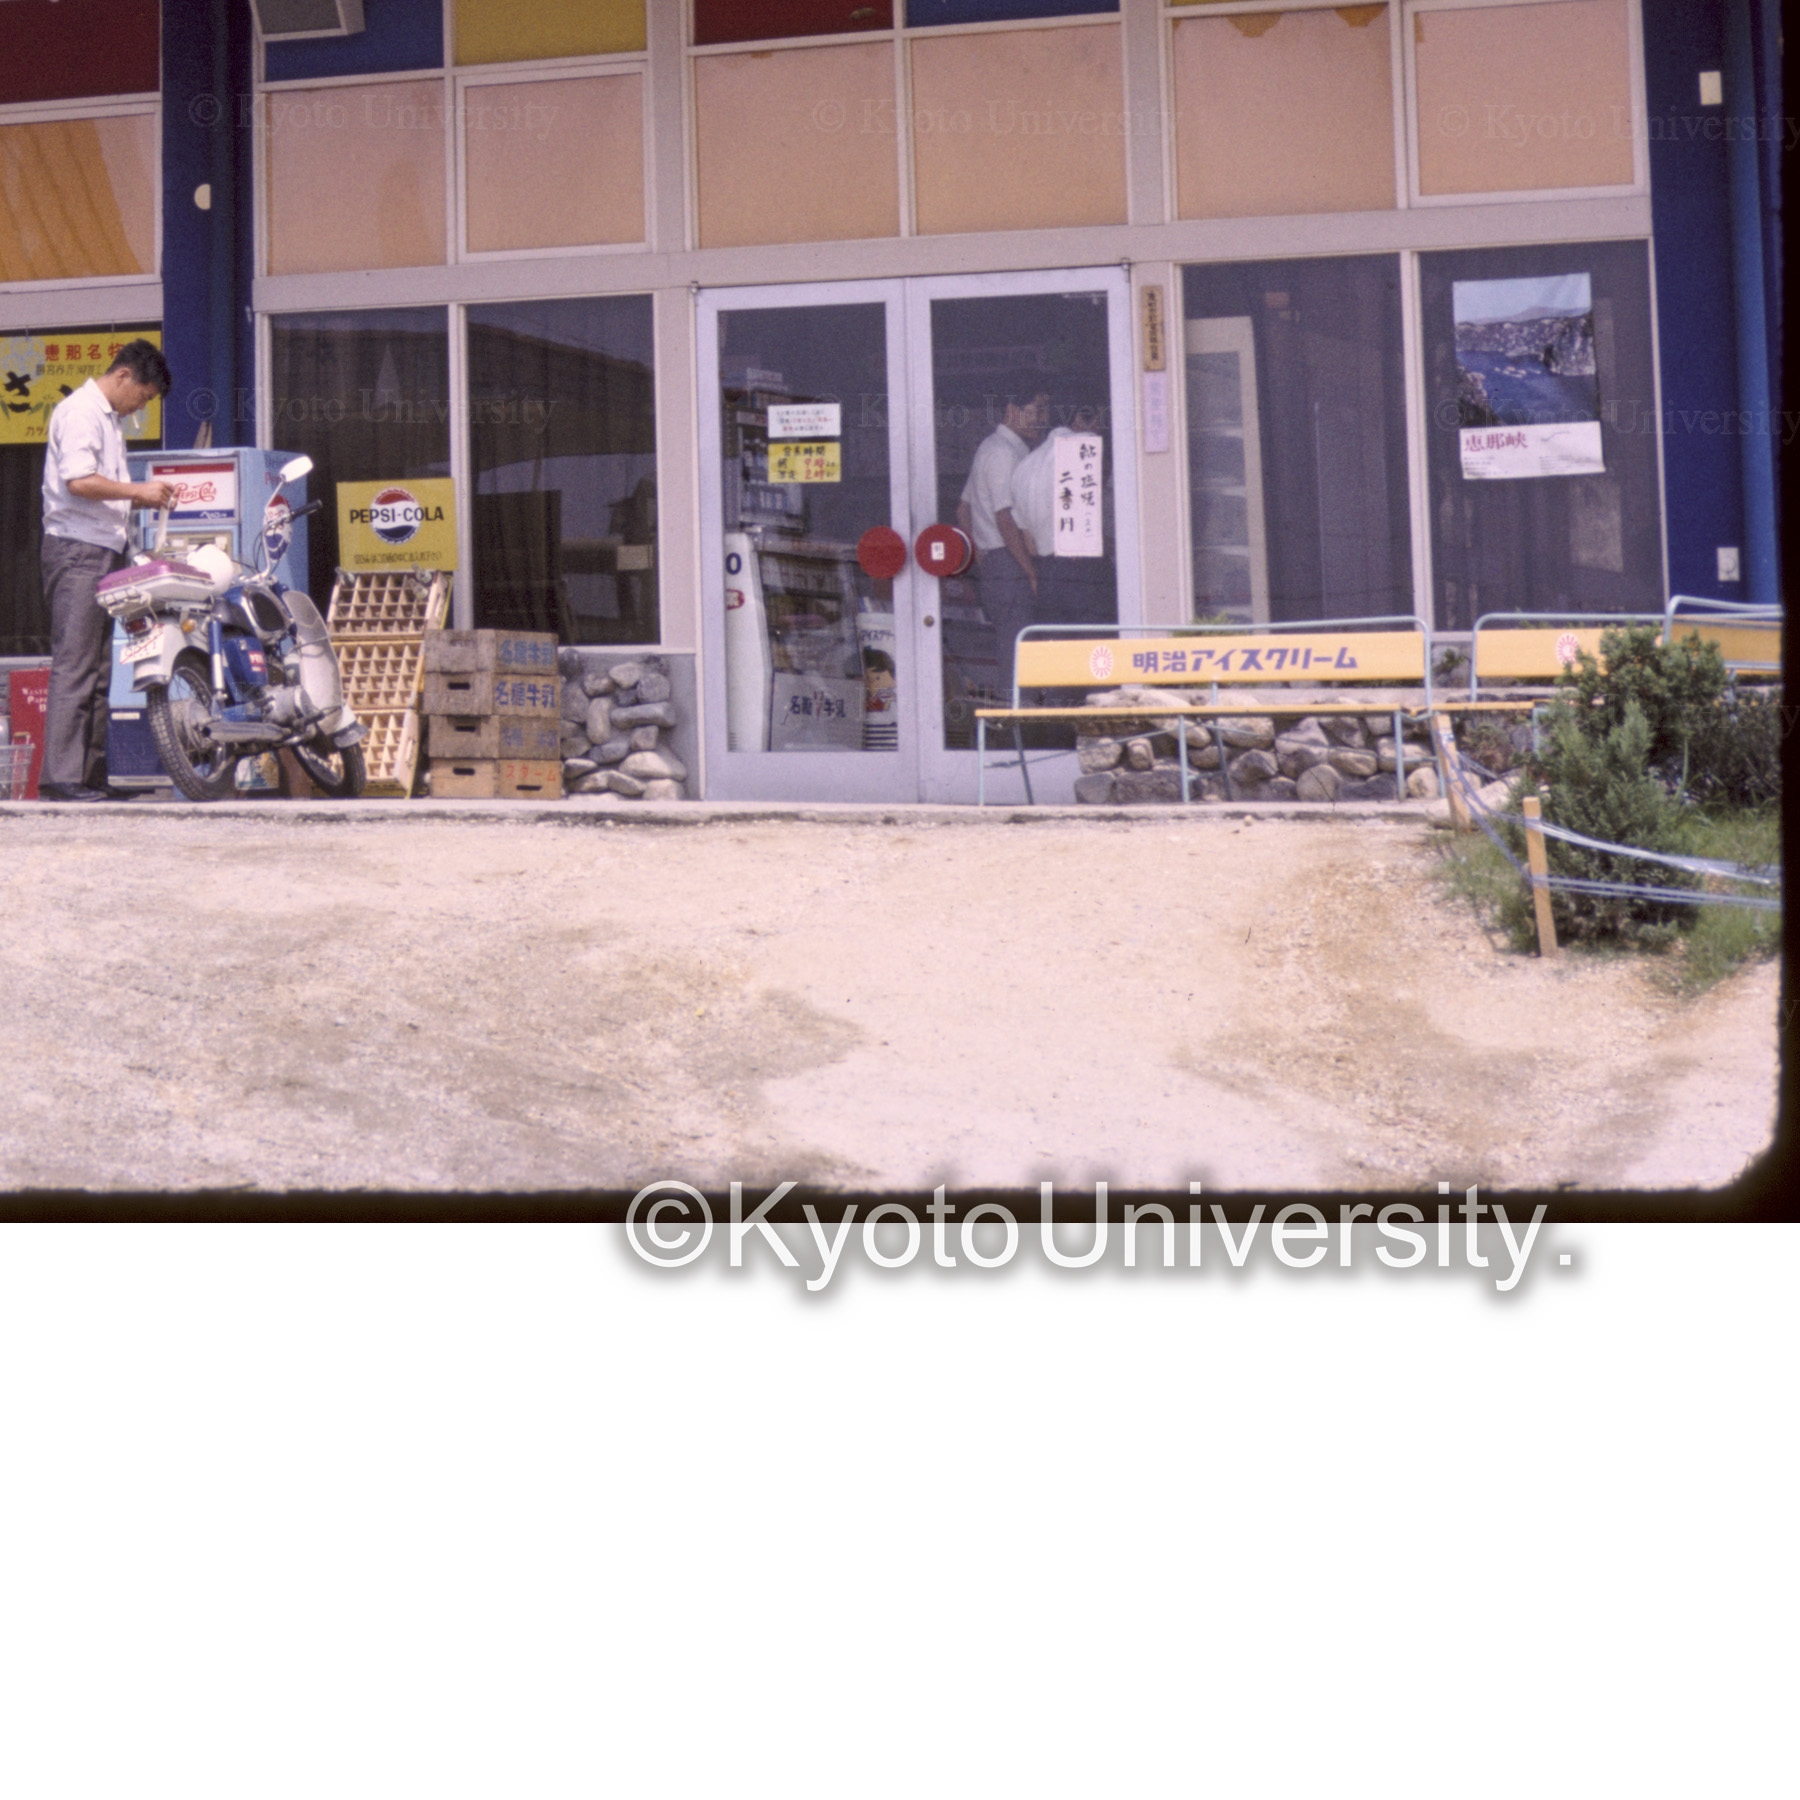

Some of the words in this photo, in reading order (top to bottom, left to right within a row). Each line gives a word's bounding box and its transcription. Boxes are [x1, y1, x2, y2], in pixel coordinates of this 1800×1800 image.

[1464, 431, 1529, 453] 恵那峡
[349, 506, 445, 525] PEPSI-COLA
[1132, 646, 1359, 674] 明治アイスクリーム
